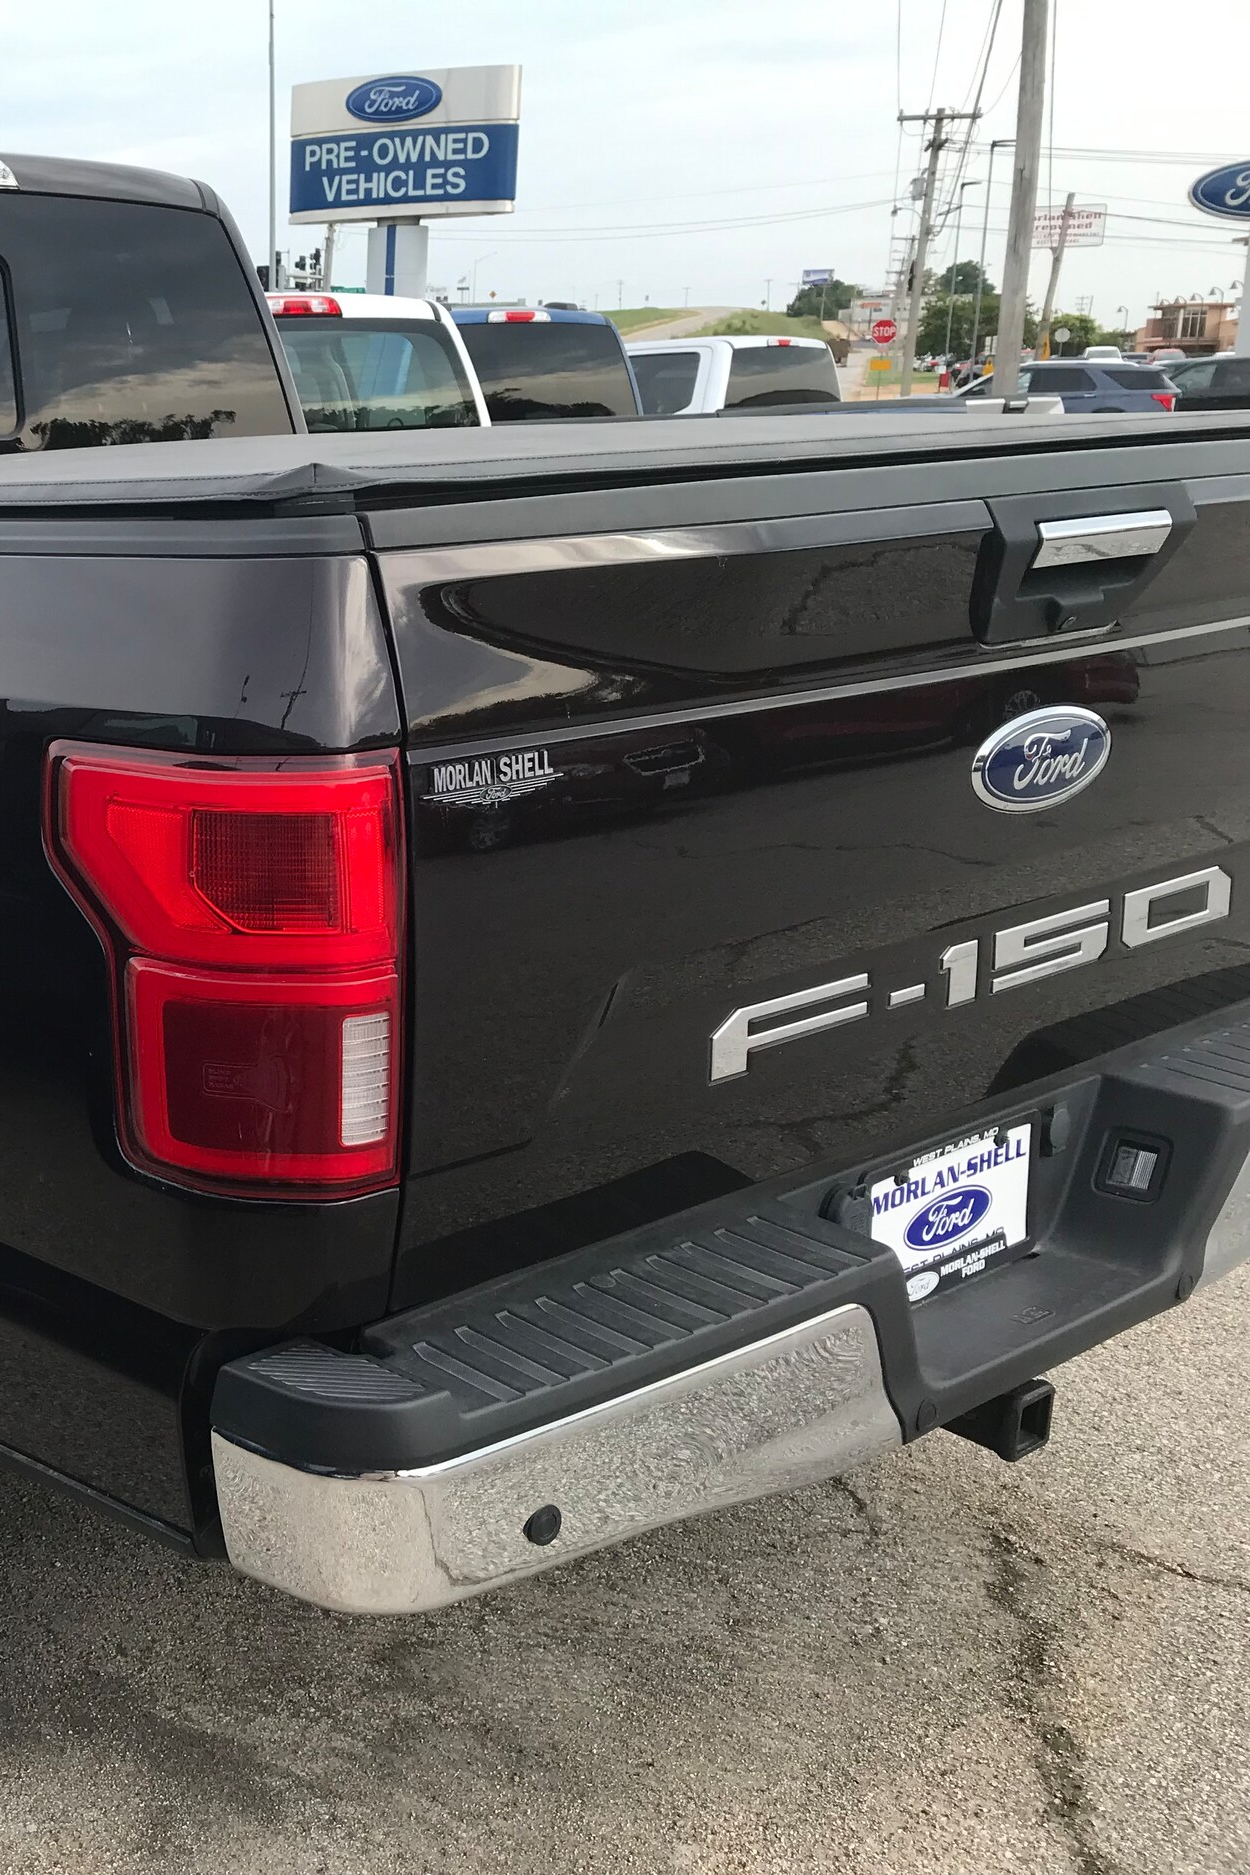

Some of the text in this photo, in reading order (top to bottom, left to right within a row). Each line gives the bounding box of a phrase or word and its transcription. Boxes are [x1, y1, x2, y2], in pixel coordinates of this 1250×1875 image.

[364, 85, 420, 113] Ford
[305, 132, 490, 171] PRE-OWNED
[322, 167, 467, 202] VEHICLES
[873, 326, 897, 337] STOP
[433, 750, 554, 793] MORLAN SHELL
[1013, 726, 1089, 791] Ford
[485, 786, 507, 800] Ford
[709, 865, 1232, 1084] F-150
[872, 1138, 1027, 1216] MORLAN-SHELL
[912, 1149, 943, 1168] WEST
[921, 1195, 975, 1242] Ford
[940, 1239, 1006, 1277] MORLAN-SHELL
[961, 1258, 986, 1278] FORD
